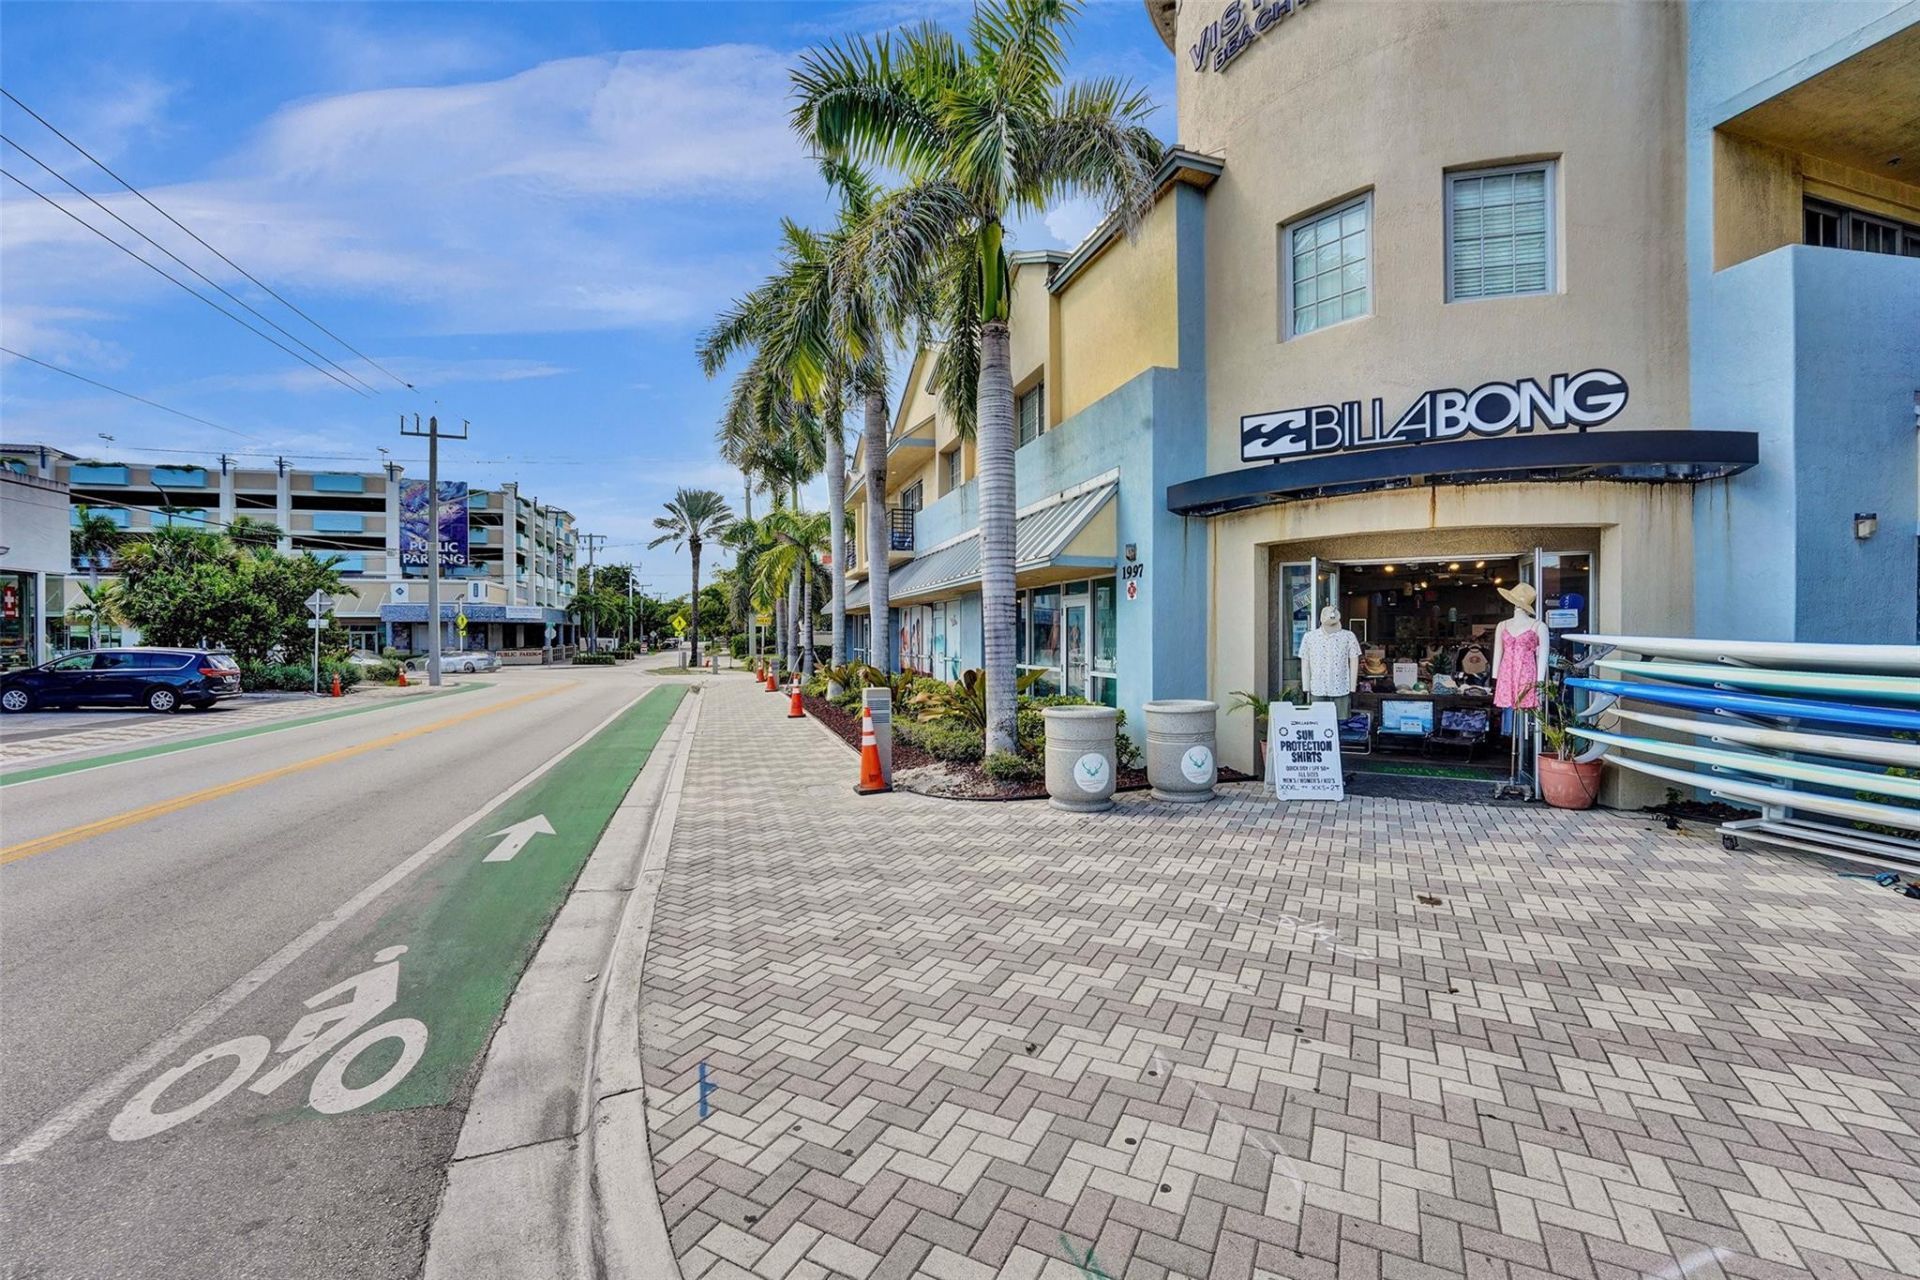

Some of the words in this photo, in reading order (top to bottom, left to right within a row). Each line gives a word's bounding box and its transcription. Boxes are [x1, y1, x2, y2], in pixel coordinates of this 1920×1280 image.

[1213, 0, 1293, 73] BEACH
[1310, 371, 1627, 451] BILLABONG
[409, 540, 459, 553] PULIC
[403, 553, 465, 564] PARING
[1122, 563, 1144, 580] 1997
[1296, 729, 1314, 740] SUN
[1280, 740, 1333, 752] PROTECTION
[1291, 751, 1323, 763] SHIRTS
